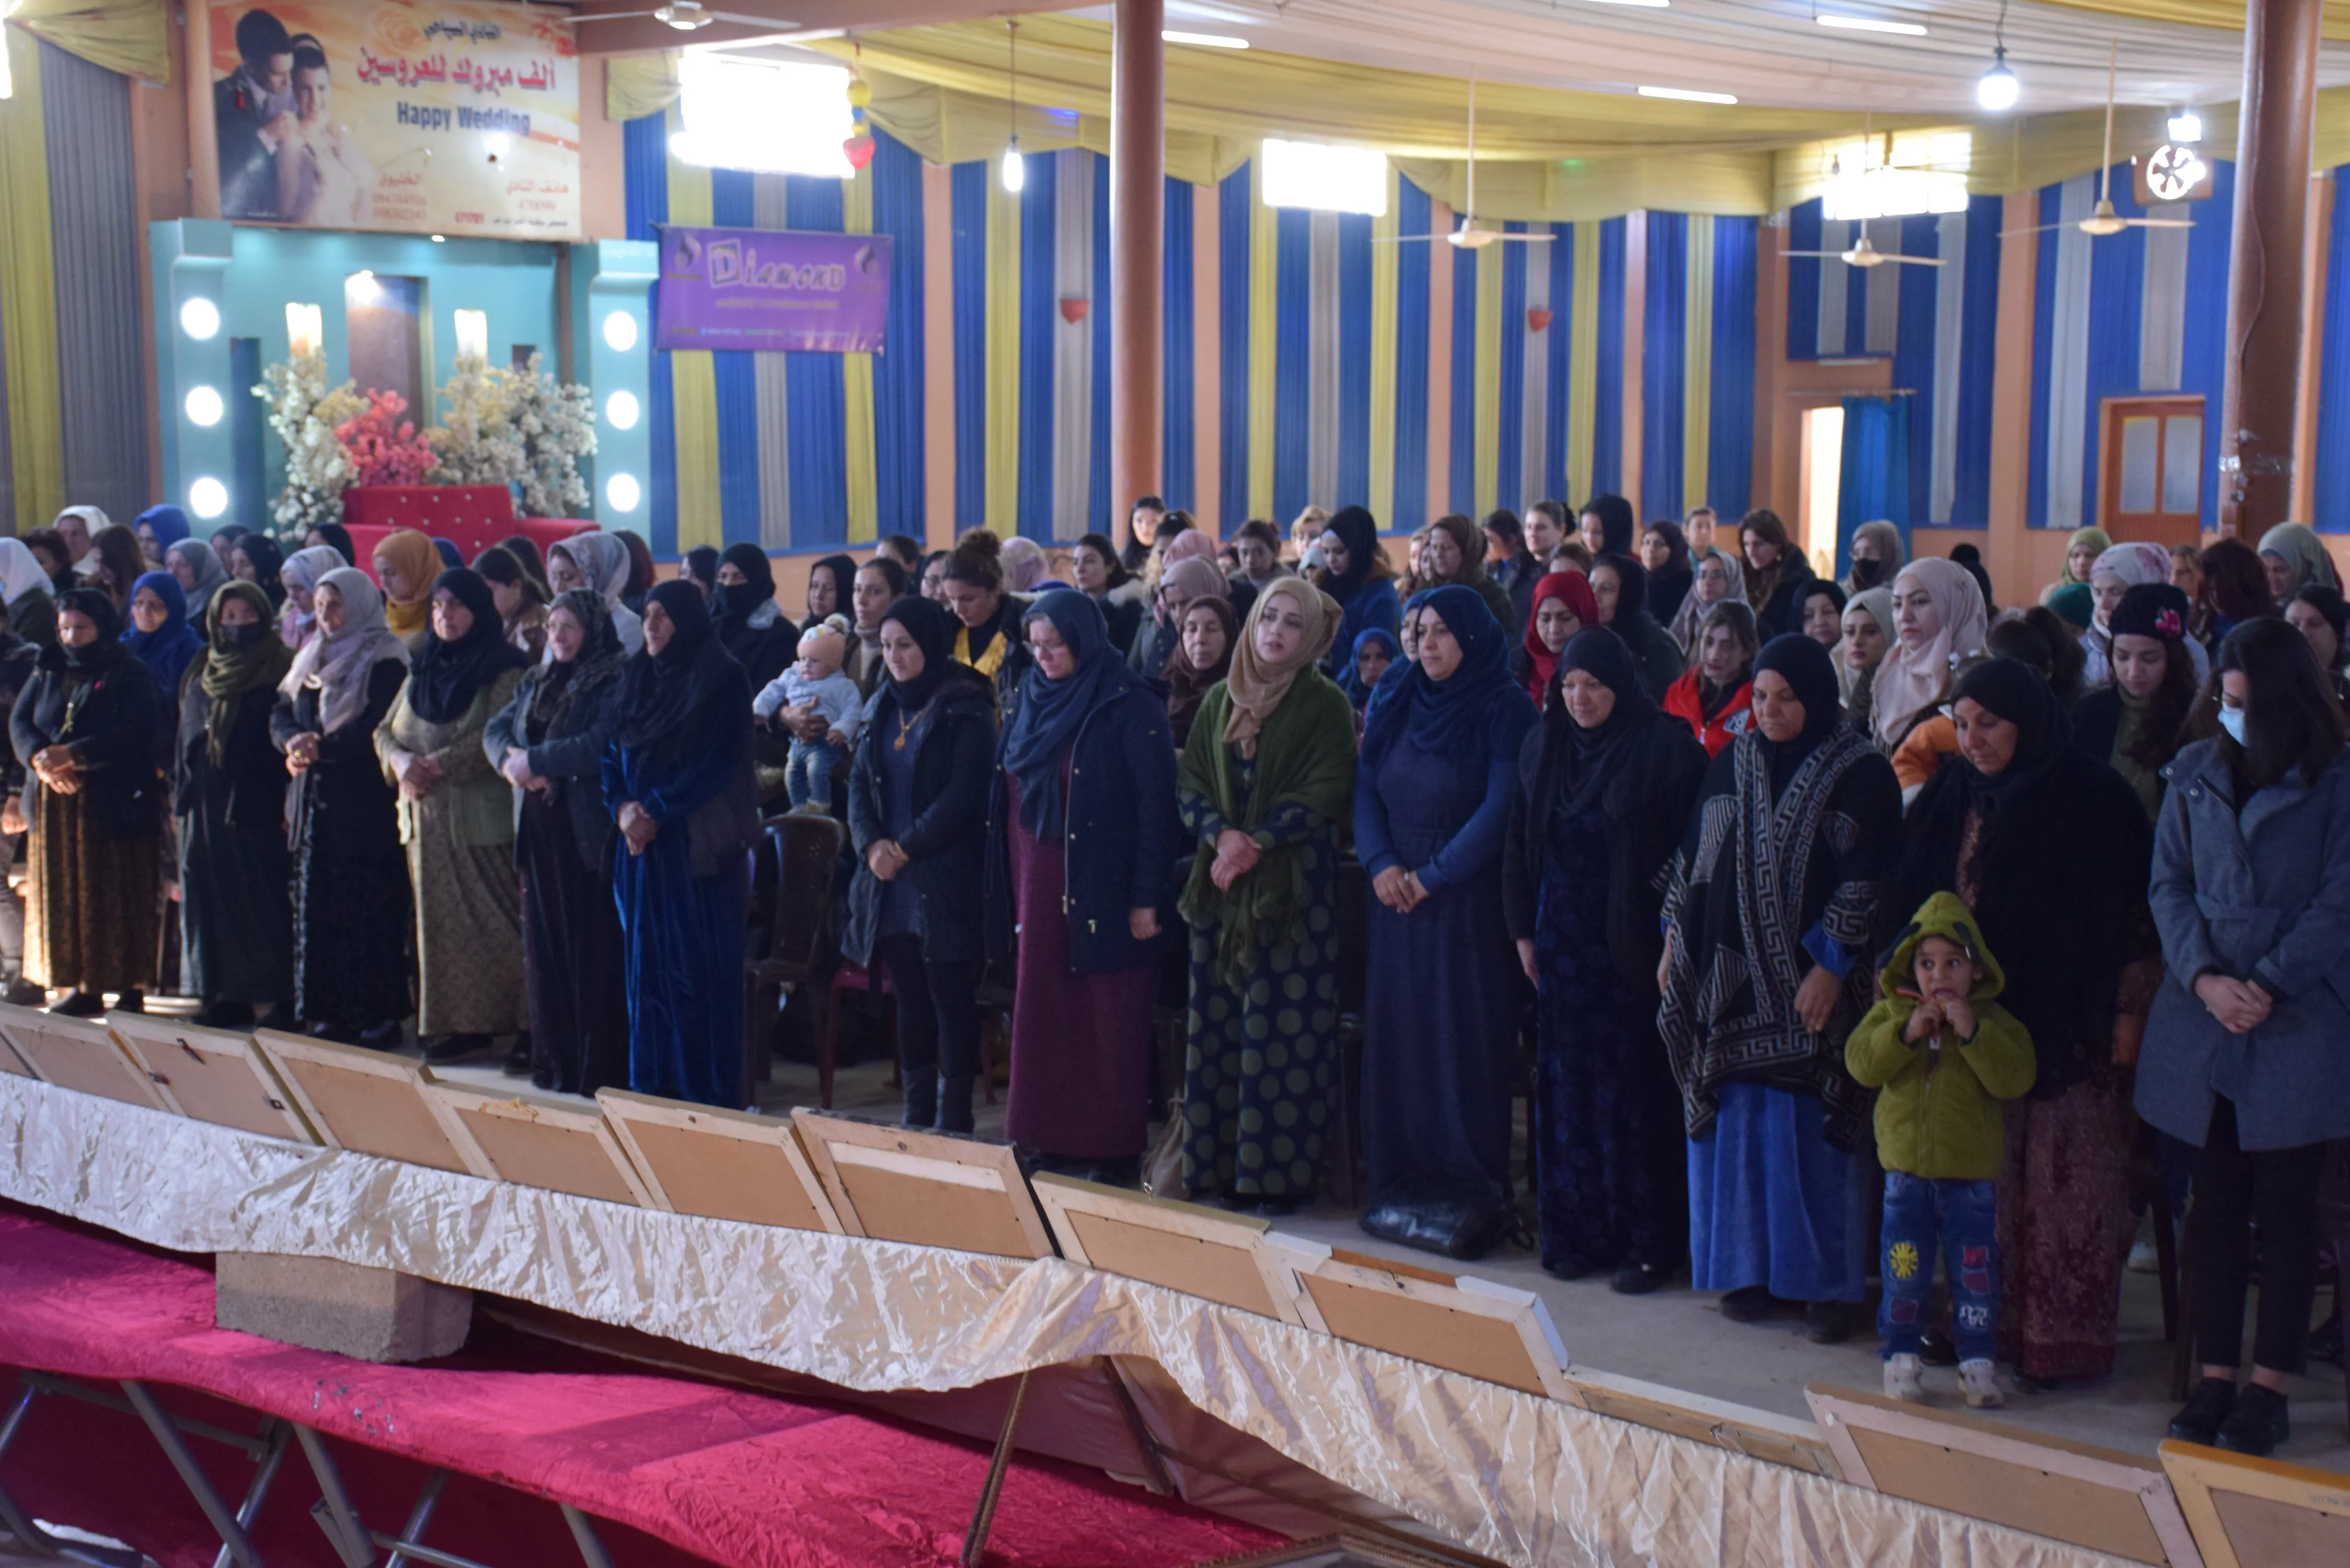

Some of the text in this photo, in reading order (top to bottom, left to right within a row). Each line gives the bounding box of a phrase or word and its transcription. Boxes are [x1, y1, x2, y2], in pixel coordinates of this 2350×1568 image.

[358, 46, 555, 97] ألف مبروك للعروسين
[397, 101, 531, 136] Happy Wedding
